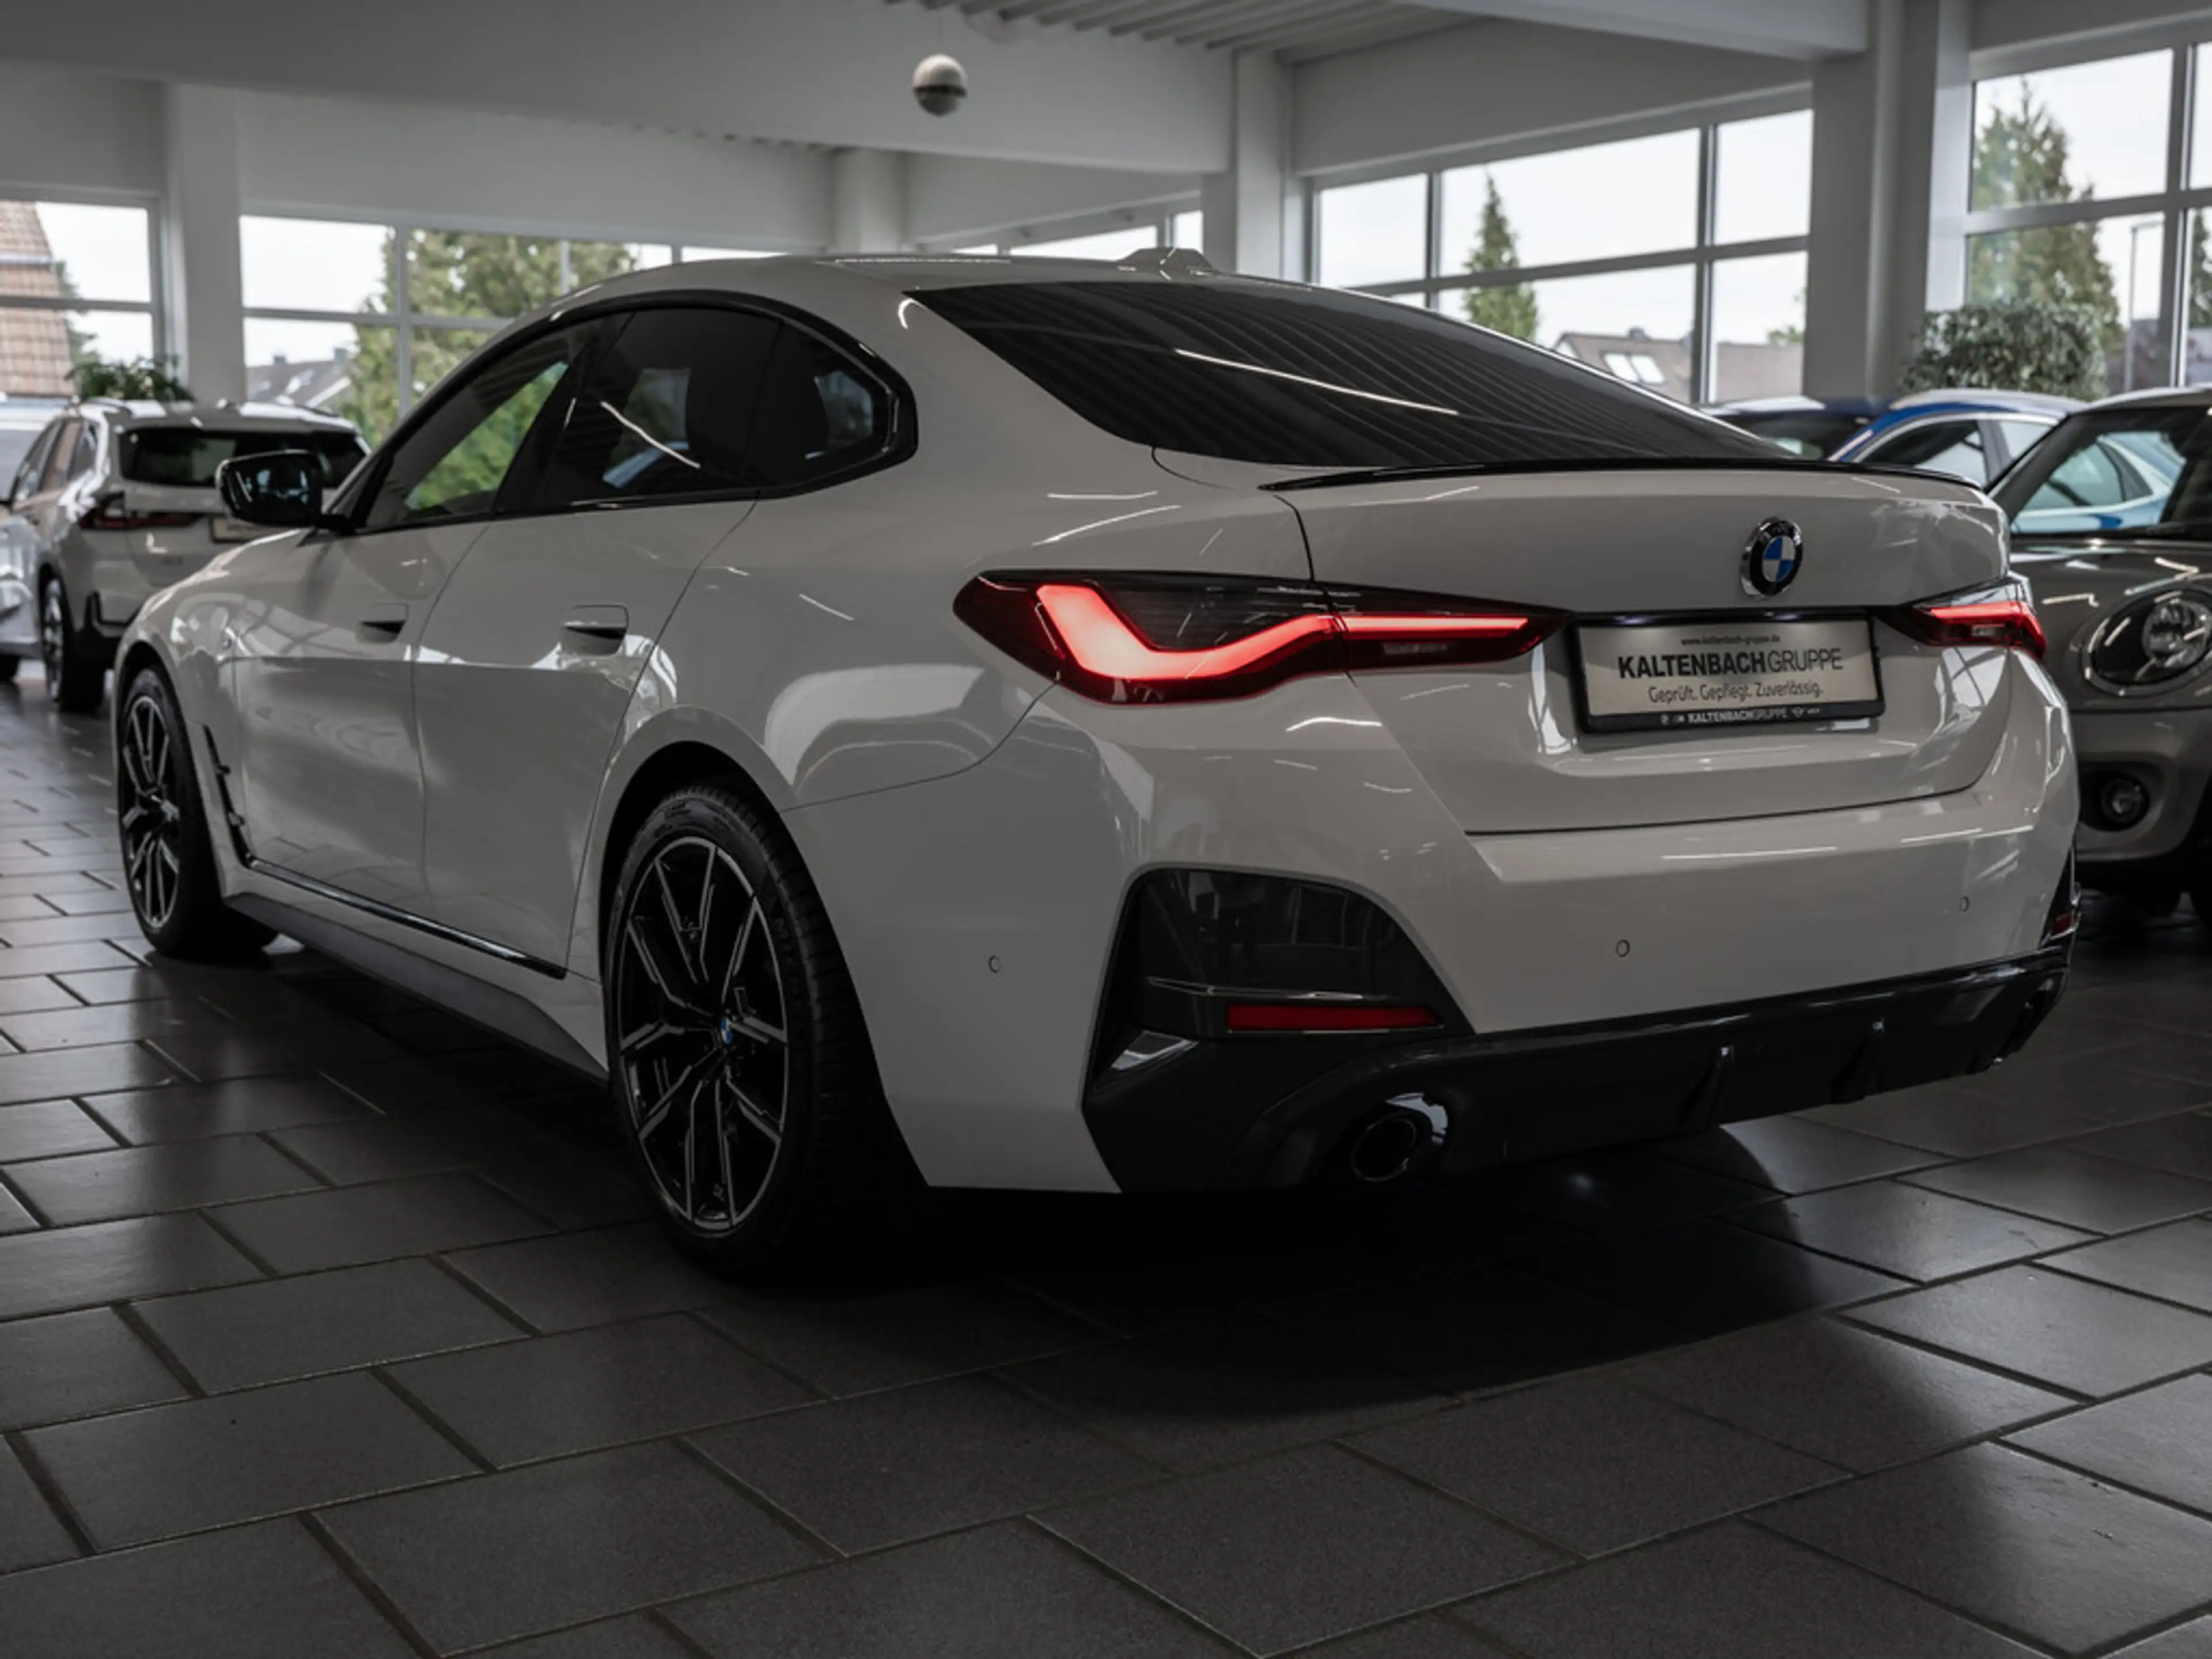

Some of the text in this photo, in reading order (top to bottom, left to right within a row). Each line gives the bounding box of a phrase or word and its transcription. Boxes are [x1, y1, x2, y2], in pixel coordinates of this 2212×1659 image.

[1618, 647, 1843, 679] KALTENBACHGRUPPE
[1648, 680, 1824, 704] Geprüft. Gepflegt. Zuverlässig.
